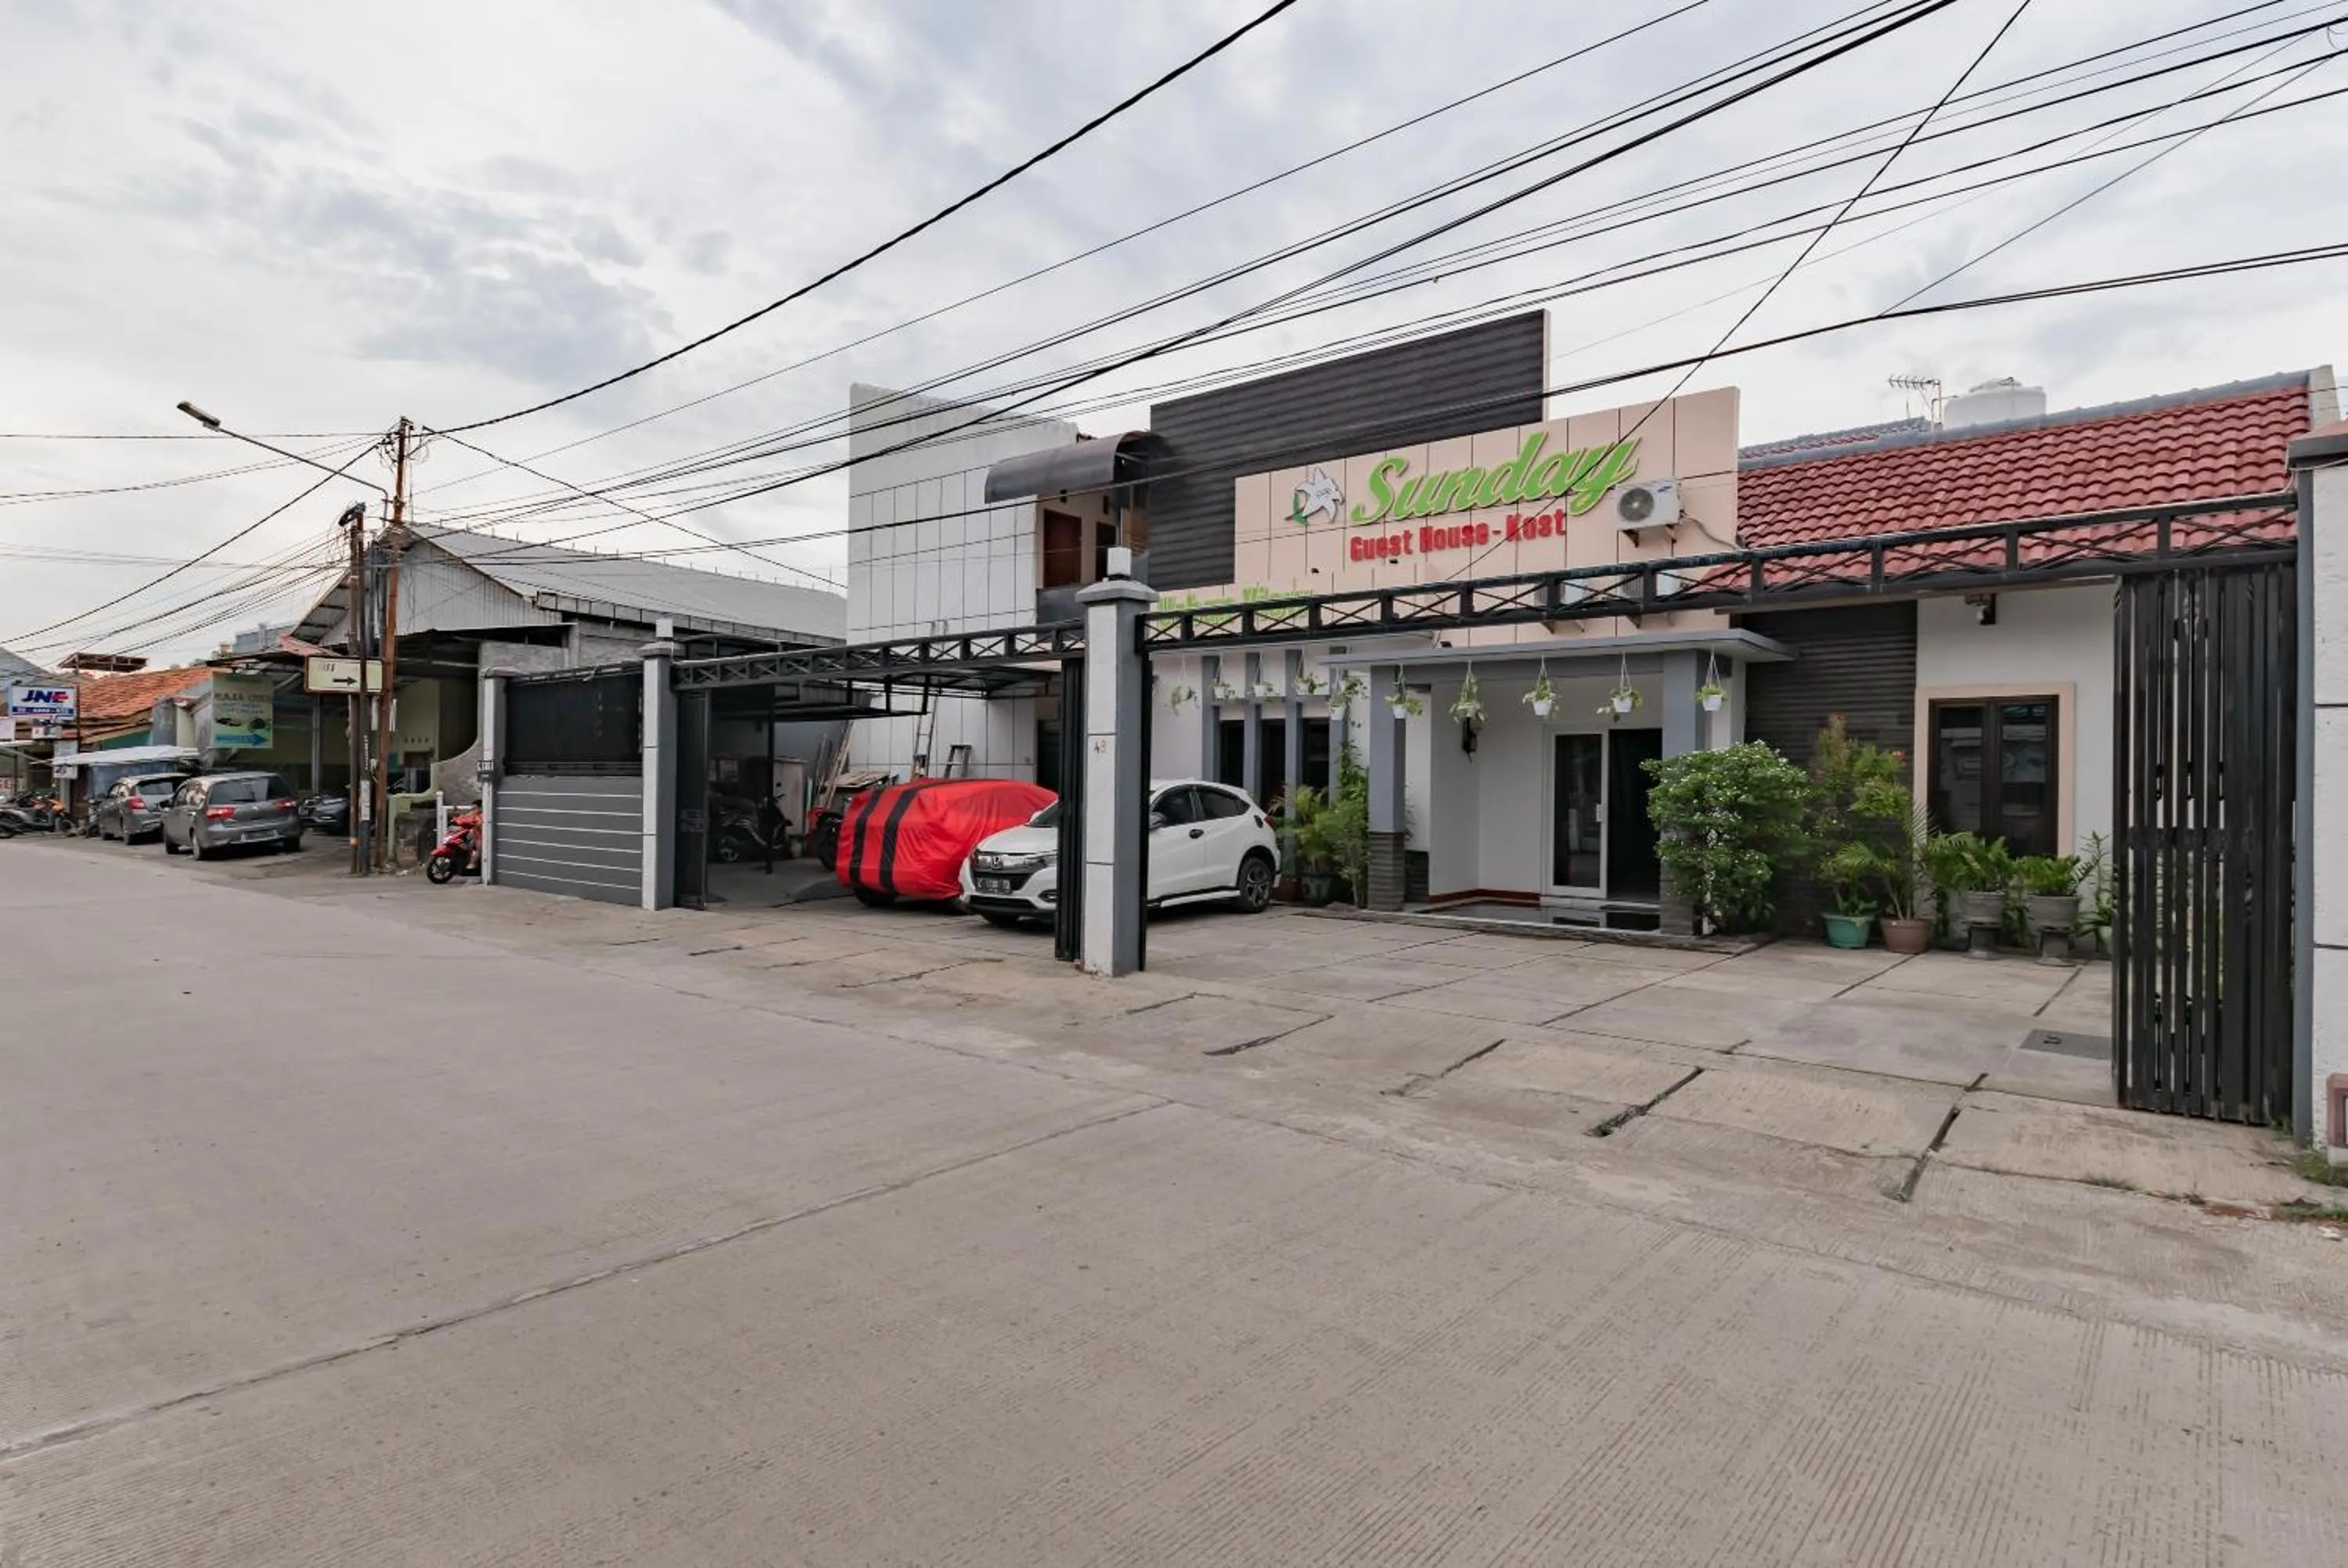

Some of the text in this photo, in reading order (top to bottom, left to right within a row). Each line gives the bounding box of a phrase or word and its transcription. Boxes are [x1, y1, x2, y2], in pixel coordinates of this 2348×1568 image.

[1352, 431, 1640, 524] Sunday
[1351, 530, 1413, 562] Guest
[1419, 522, 1488, 553] House
[1505, 508, 1566, 542] Kost
[22, 689, 69, 703] JNE
